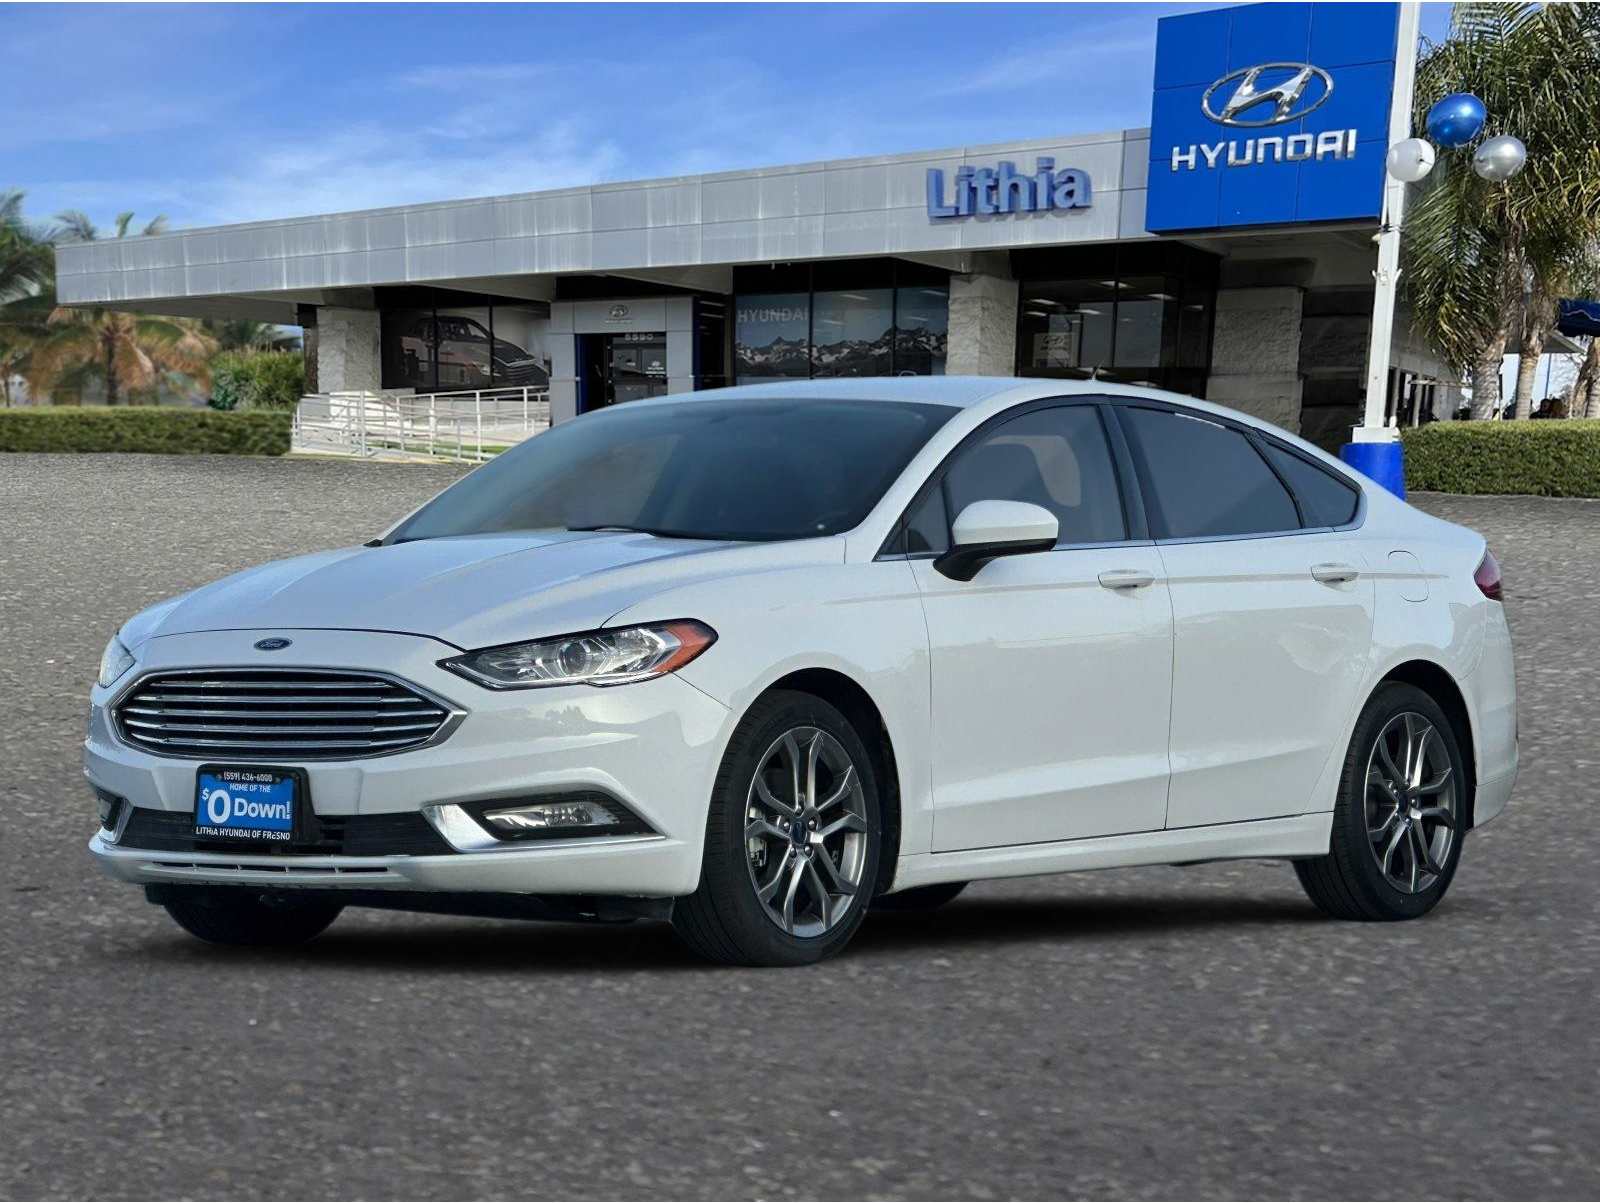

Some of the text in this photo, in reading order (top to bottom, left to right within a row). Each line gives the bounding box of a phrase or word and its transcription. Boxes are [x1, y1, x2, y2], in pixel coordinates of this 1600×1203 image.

[1171, 129, 1357, 171] HYUNDAI
[926, 156, 1092, 218] Lithia
[737, 308, 808, 322] HYUNDAI
[223, 772, 273, 782] (559) 436-6000
[229, 783, 272, 793] HOME OF THE
[234, 798, 290, 819] Down!
[219, 828, 250, 838] HYUNDAI
[252, 830, 261, 838] OF
